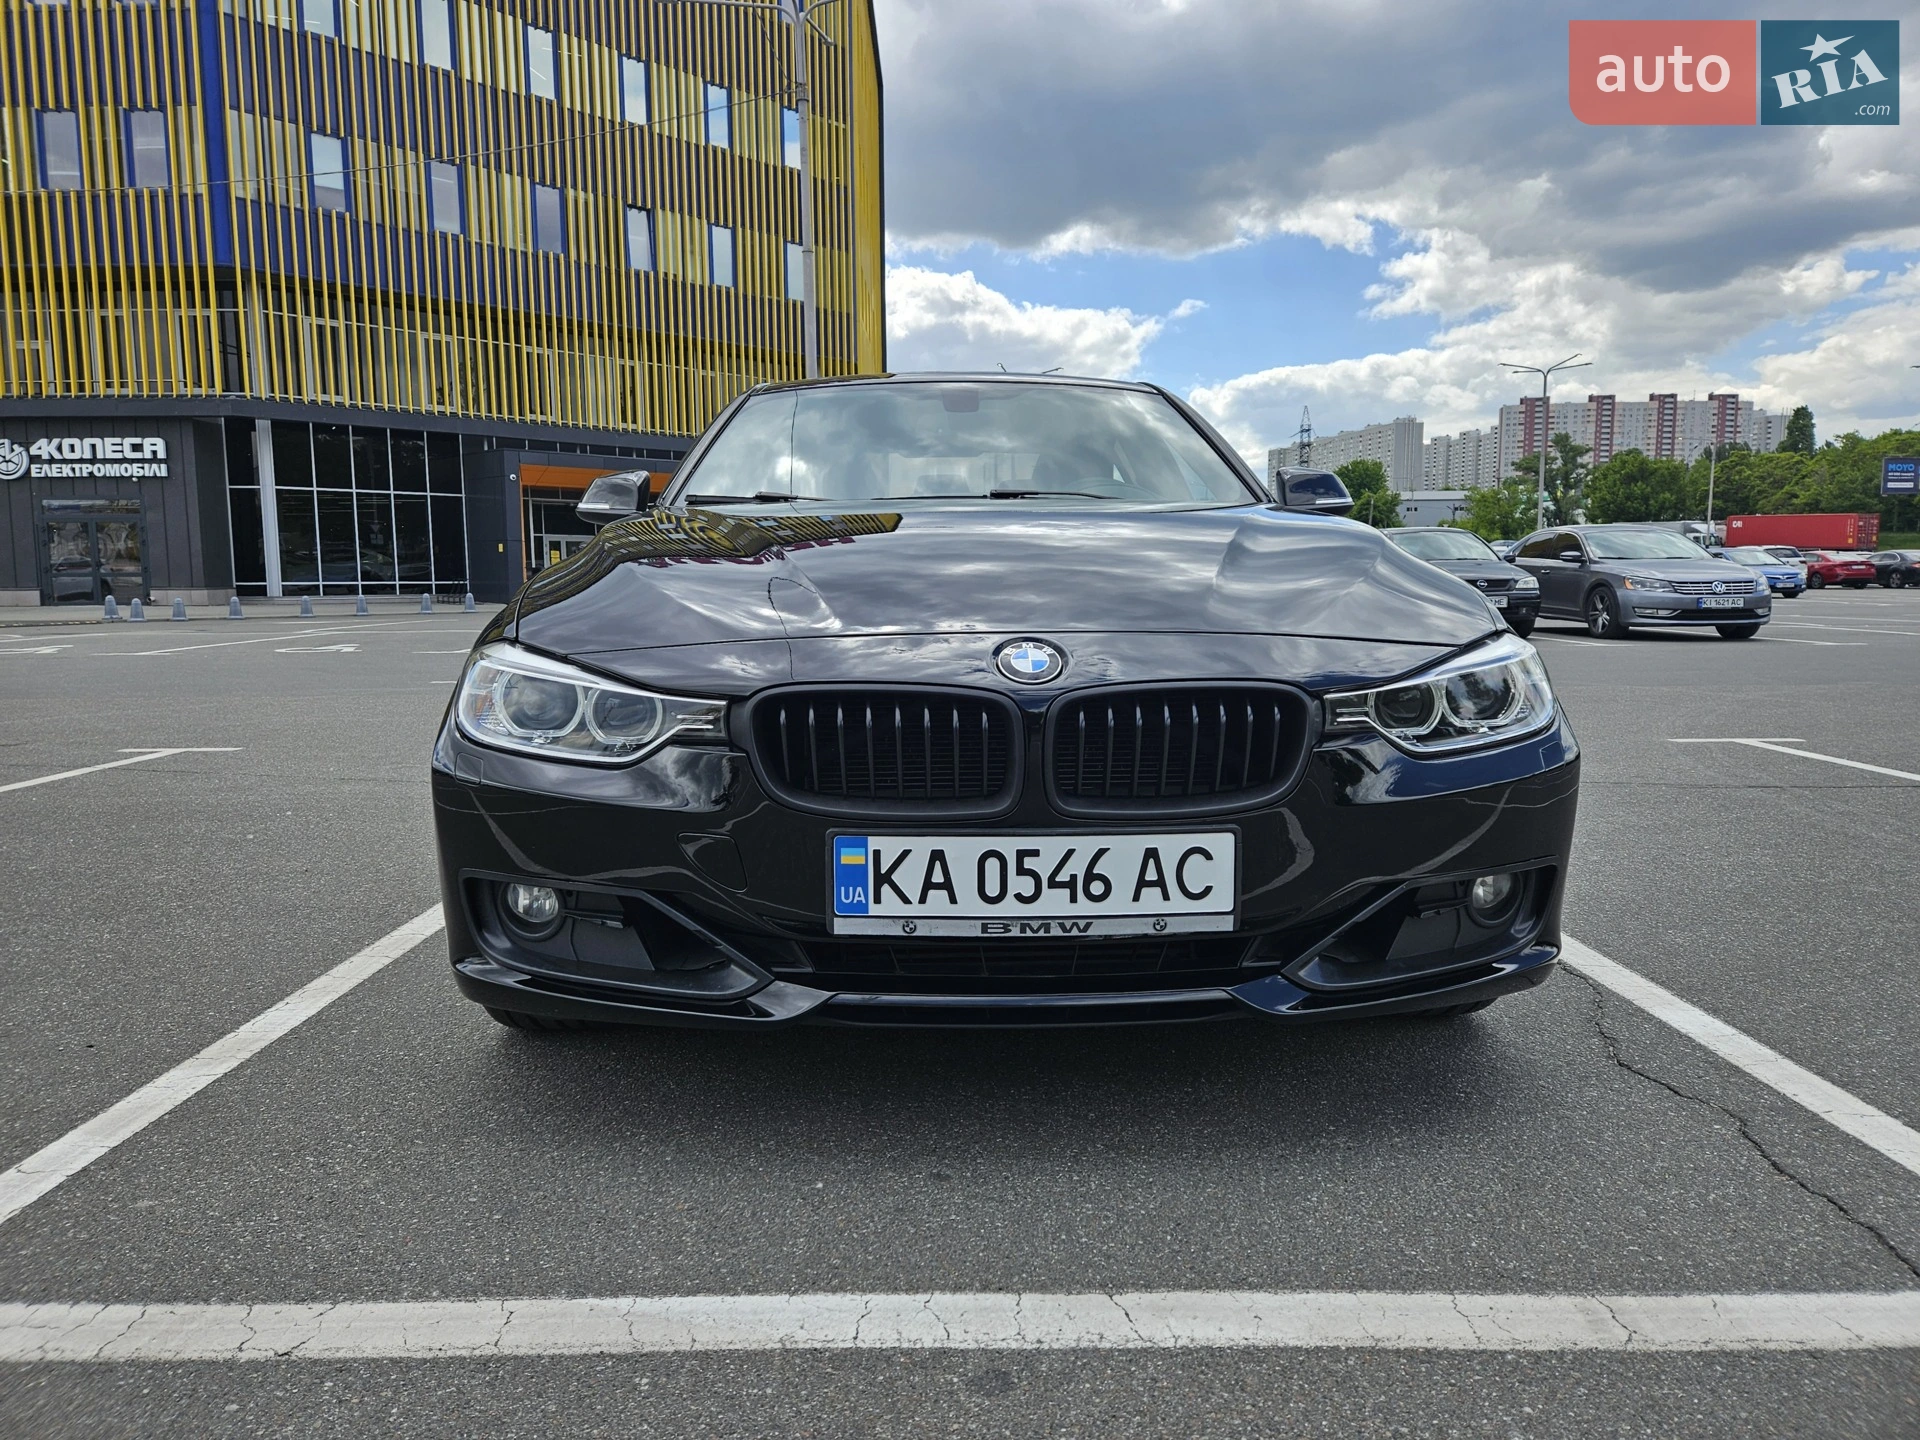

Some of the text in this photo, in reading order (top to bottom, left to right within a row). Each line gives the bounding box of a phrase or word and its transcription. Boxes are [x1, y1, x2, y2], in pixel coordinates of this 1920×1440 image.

[30, 463, 169, 478] ЕЛЕКТРОМОБІЛІ
[1888, 463, 1915, 471] MOYO
[1703, 598, 1712, 606] KI
[1714, 598, 1730, 606] 1621
[1731, 598, 1742, 606] AC
[1004, 642, 1055, 655] BMW
[872, 846, 1214, 905] KA 0546 AC
[840, 886, 866, 904] UA
[980, 921, 1094, 935] BMW
